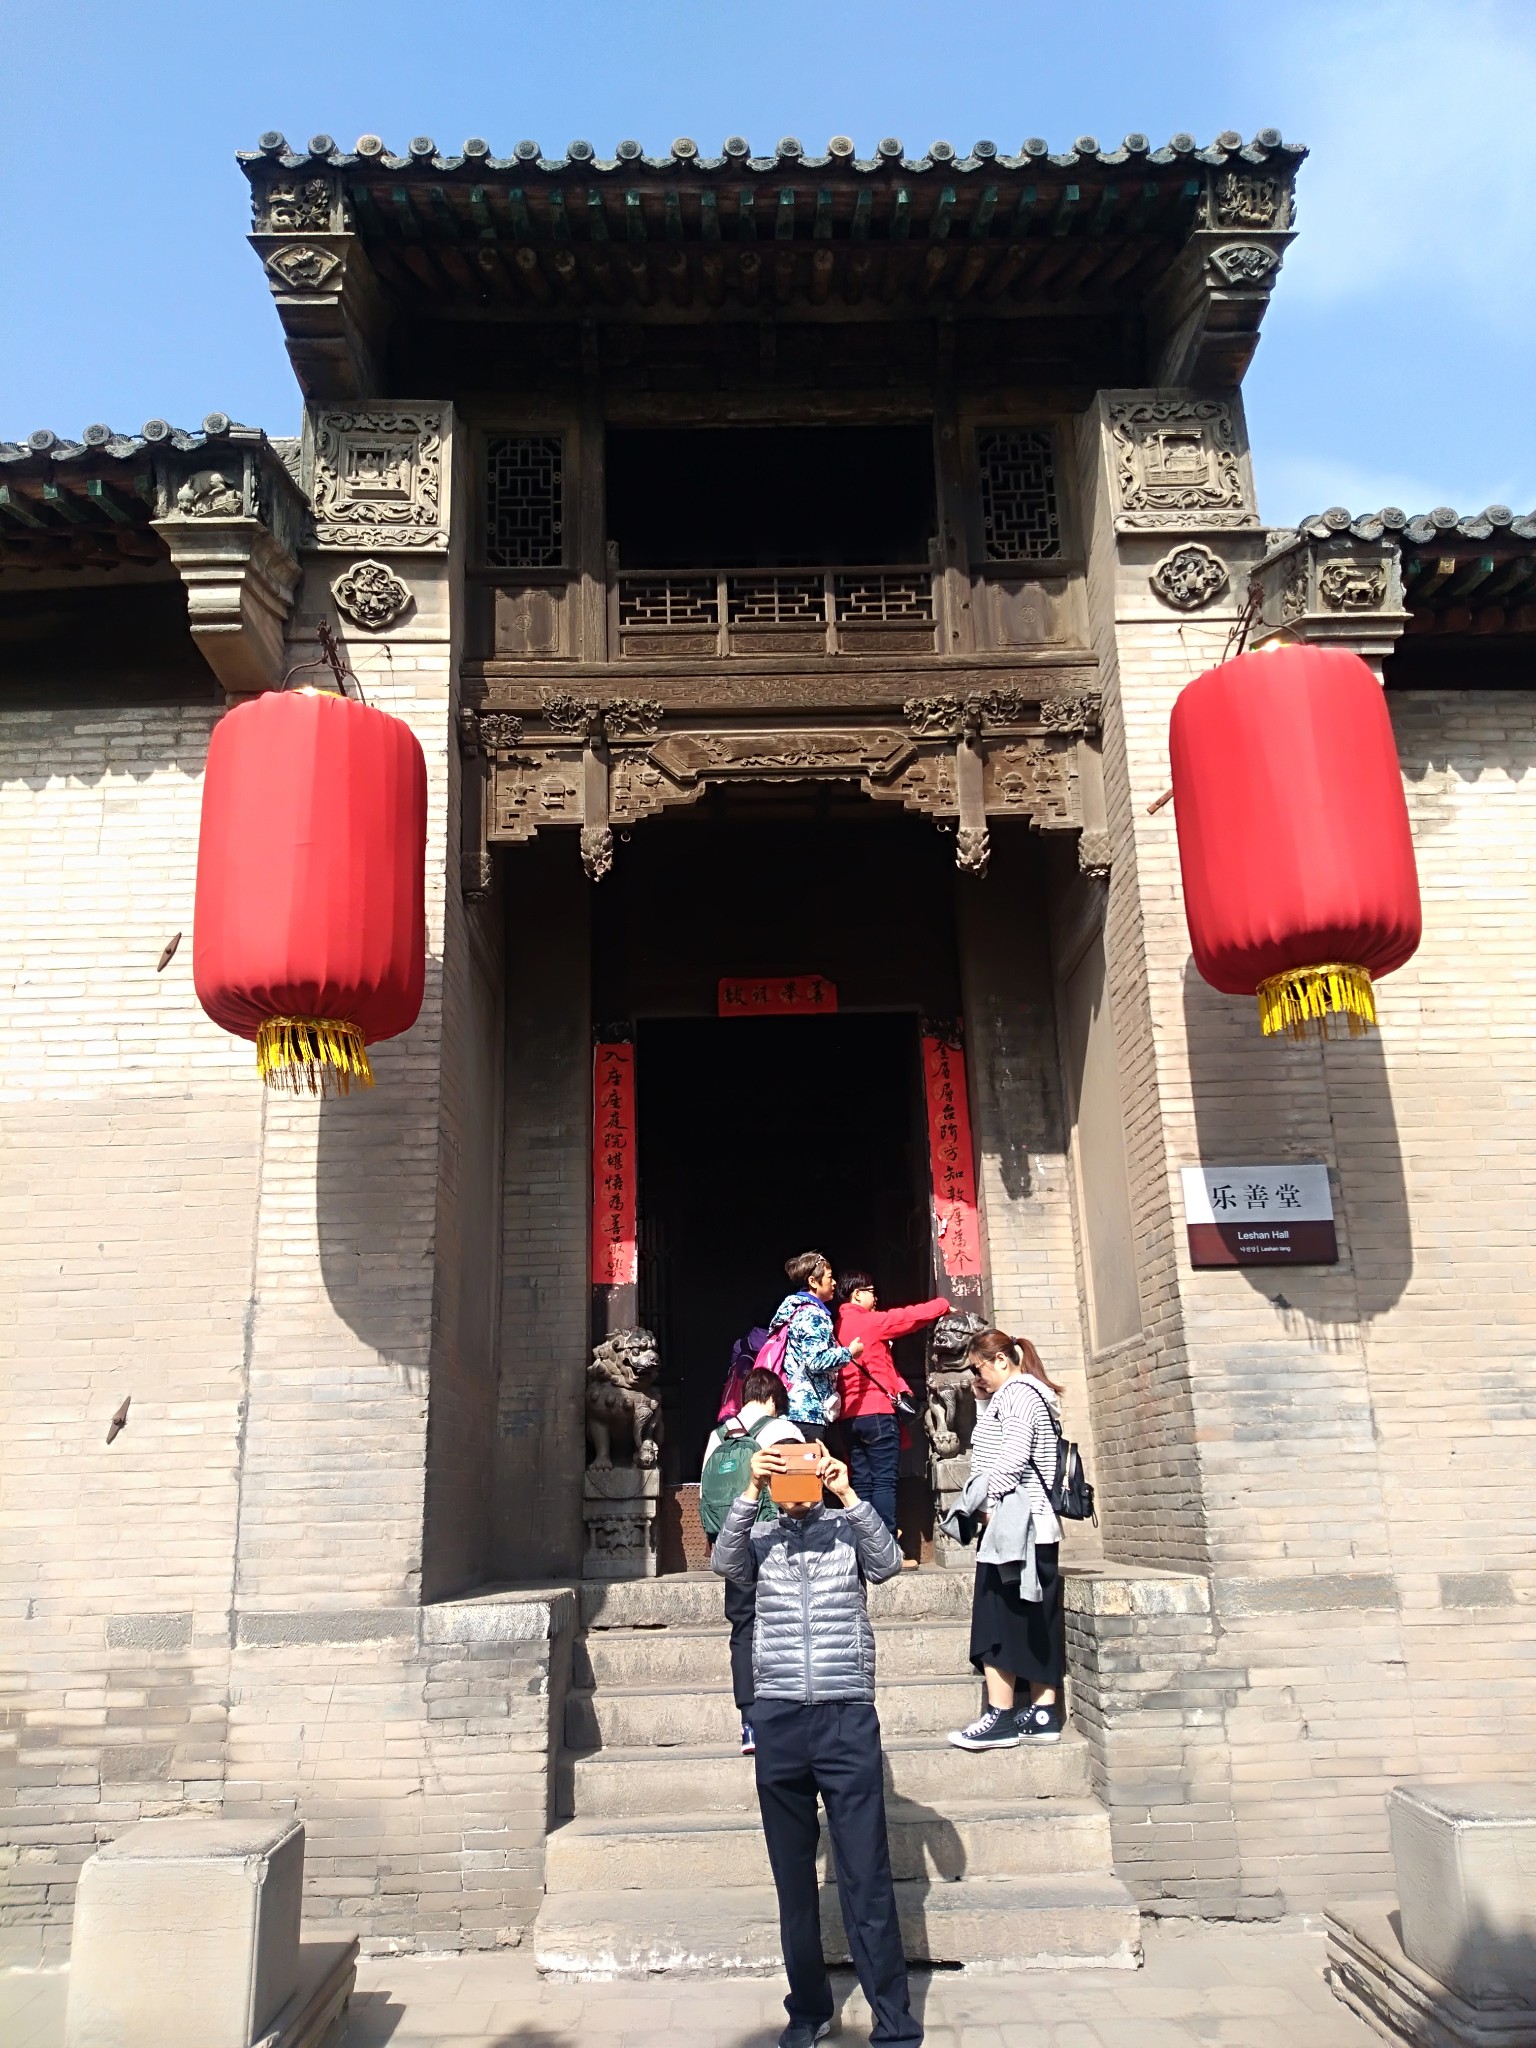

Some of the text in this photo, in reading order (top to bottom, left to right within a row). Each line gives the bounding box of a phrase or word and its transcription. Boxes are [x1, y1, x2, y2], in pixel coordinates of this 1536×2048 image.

[1213, 1184, 1302, 1210] 乐善堂
[1237, 1230, 1290, 1240] Leshan Hall
